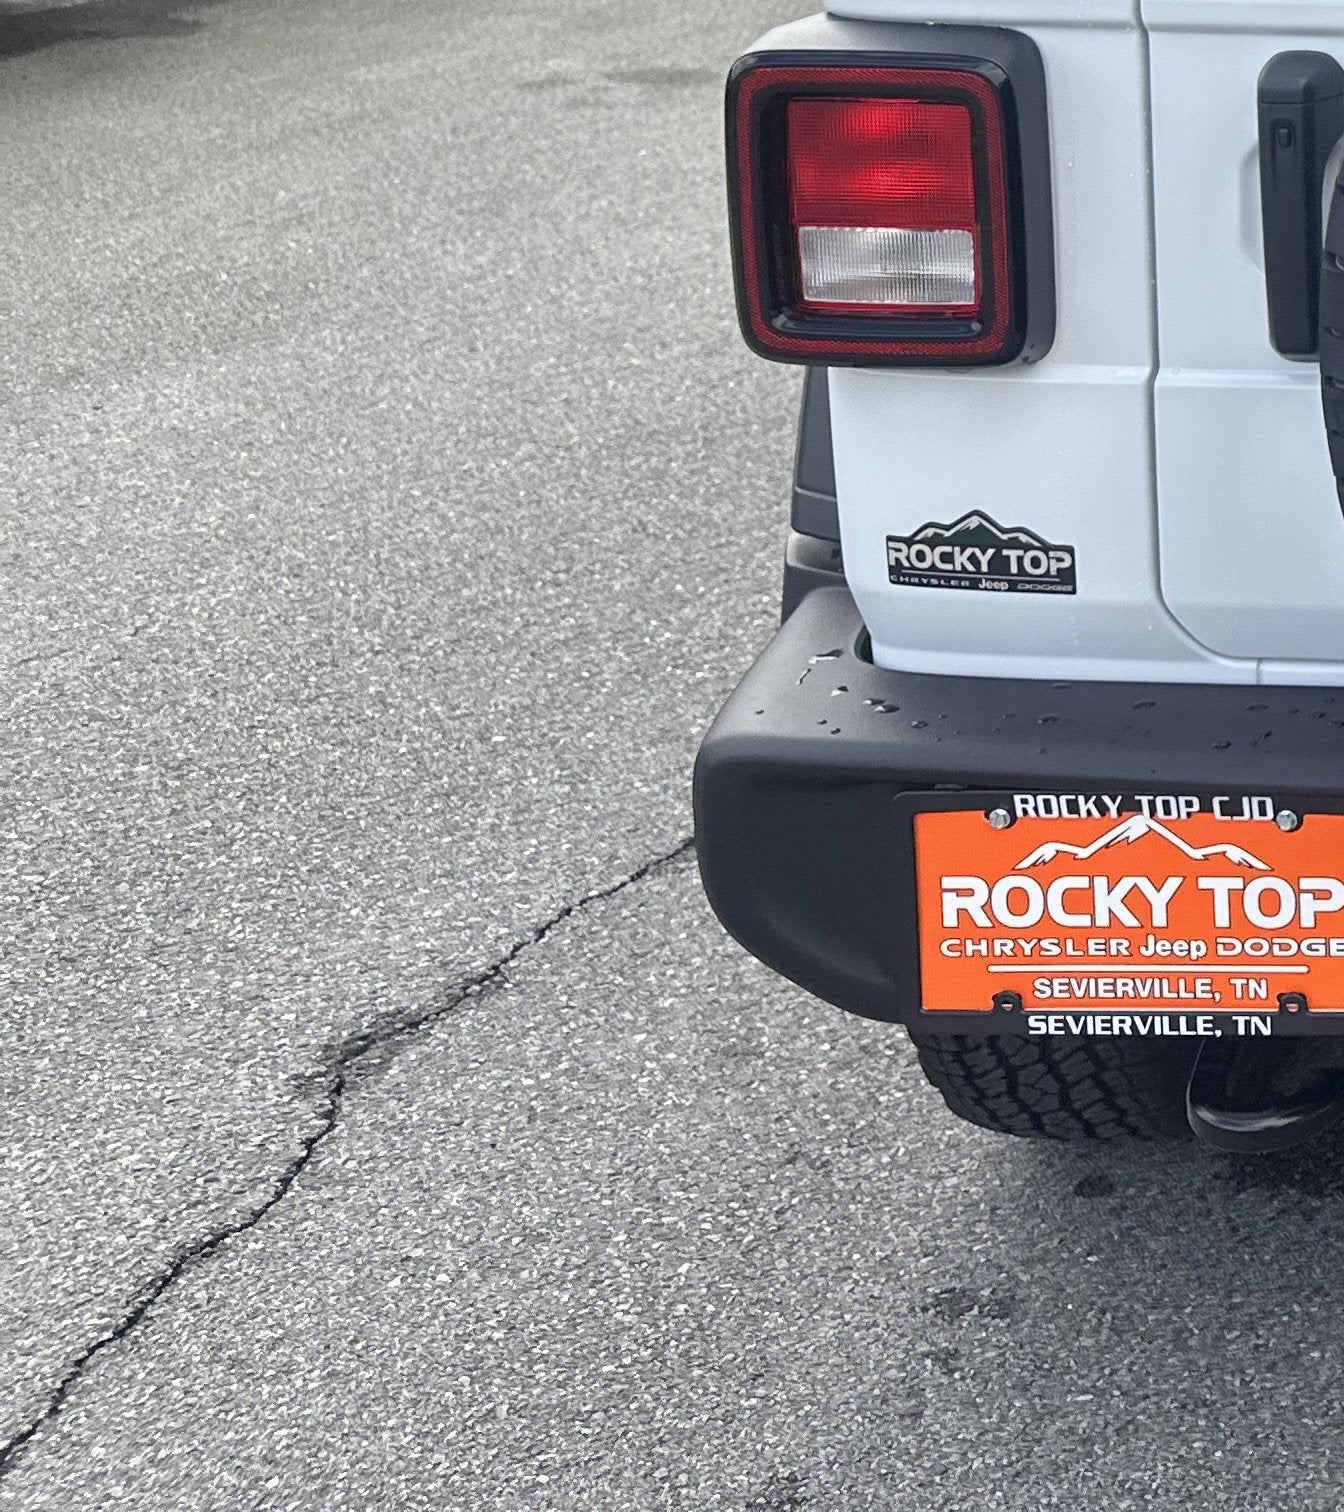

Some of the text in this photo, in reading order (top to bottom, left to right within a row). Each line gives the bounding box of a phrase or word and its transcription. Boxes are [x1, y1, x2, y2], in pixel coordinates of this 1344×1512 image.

[887, 540, 1073, 576] ROCKY TOP
[890, 574, 1074, 592] CHRYSLER Jeep DODGE
[1013, 793, 1275, 822] ROCKY TOP CJD
[940, 874, 1185, 929] ROCKY
[939, 937, 1130, 959] CHRYSLER
[1138, 933, 1208, 961] Jeep
[1032, 977, 1269, 1002] SEVIERVILLE, TN
[1027, 1015, 1272, 1038] SEVIERVILLE, TN
